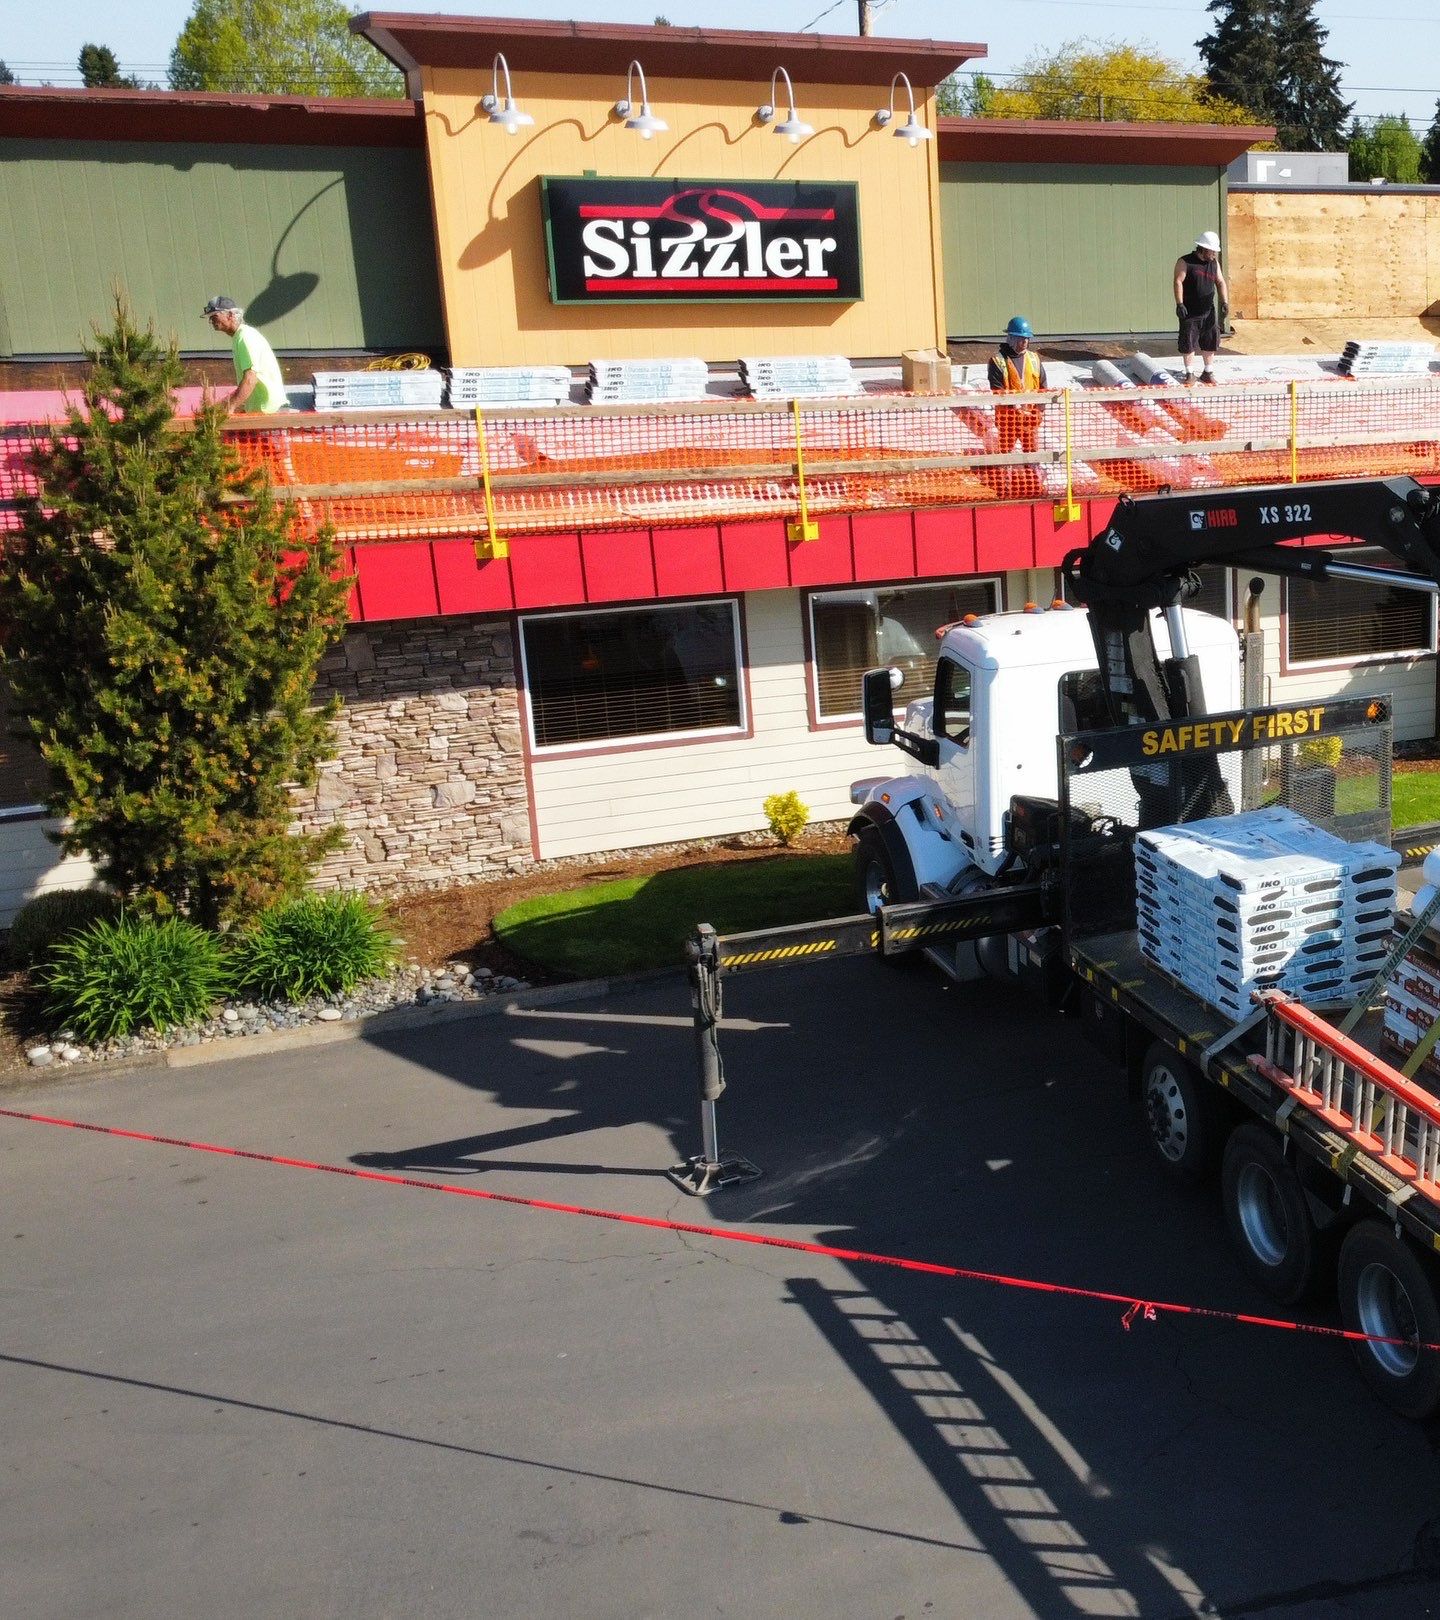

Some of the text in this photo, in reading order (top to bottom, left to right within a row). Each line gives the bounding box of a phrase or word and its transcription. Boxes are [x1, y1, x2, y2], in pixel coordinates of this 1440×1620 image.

[582, 216, 837, 278] Sizzler
[1260, 506, 1280, 525] XS
[1285, 504, 1312, 523] 322
[1142, 707, 1325, 756] SAFETY FIRST
[1260, 880, 1280, 889] IKO
[1256, 903, 1276, 912] IKO
[1255, 925, 1275, 933] IKO
[1257, 943, 1277, 952] IKO
[1256, 965, 1276, 974] IKO
